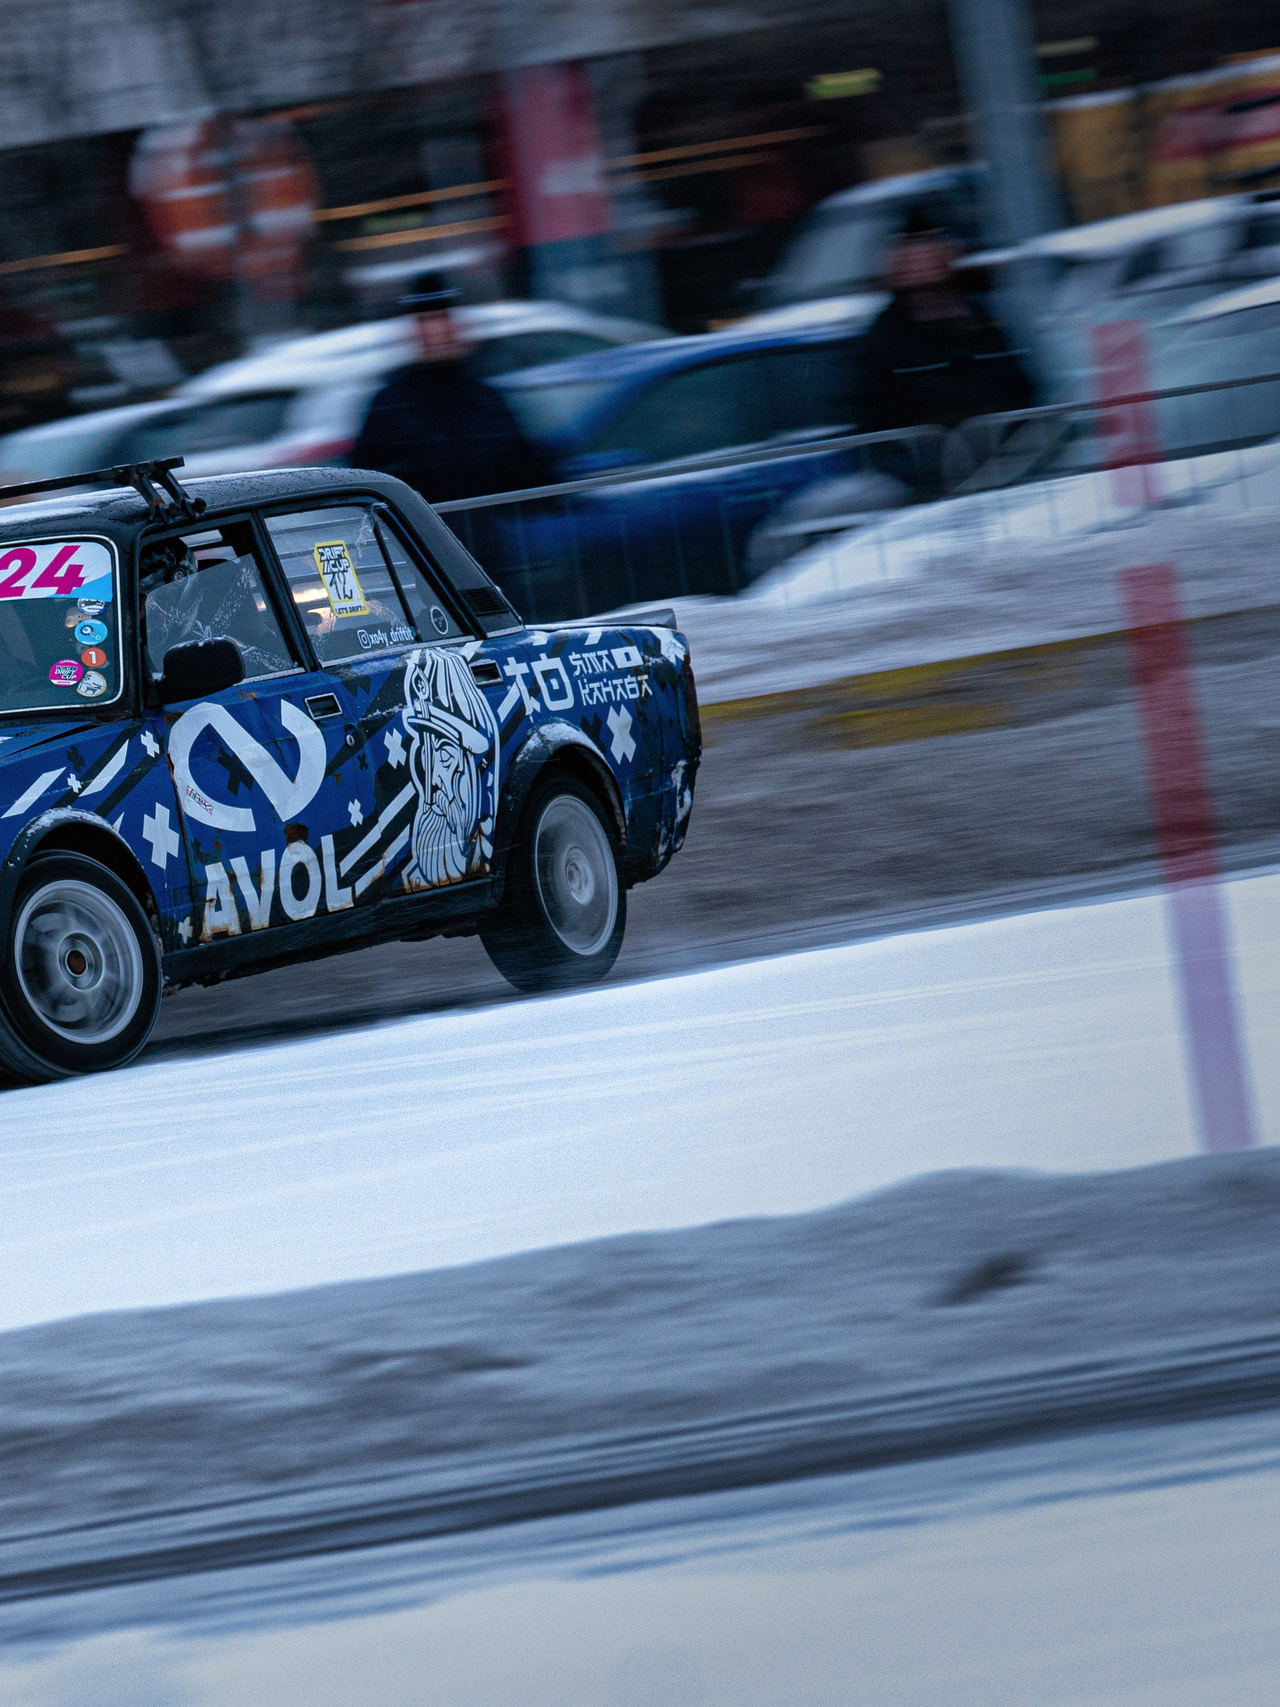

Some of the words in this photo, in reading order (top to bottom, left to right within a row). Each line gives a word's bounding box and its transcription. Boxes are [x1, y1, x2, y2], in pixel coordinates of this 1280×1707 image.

[318, 546, 345, 561] DRIFT
[88, 650, 98, 665] 1
[198, 834, 355, 942] AVOL
